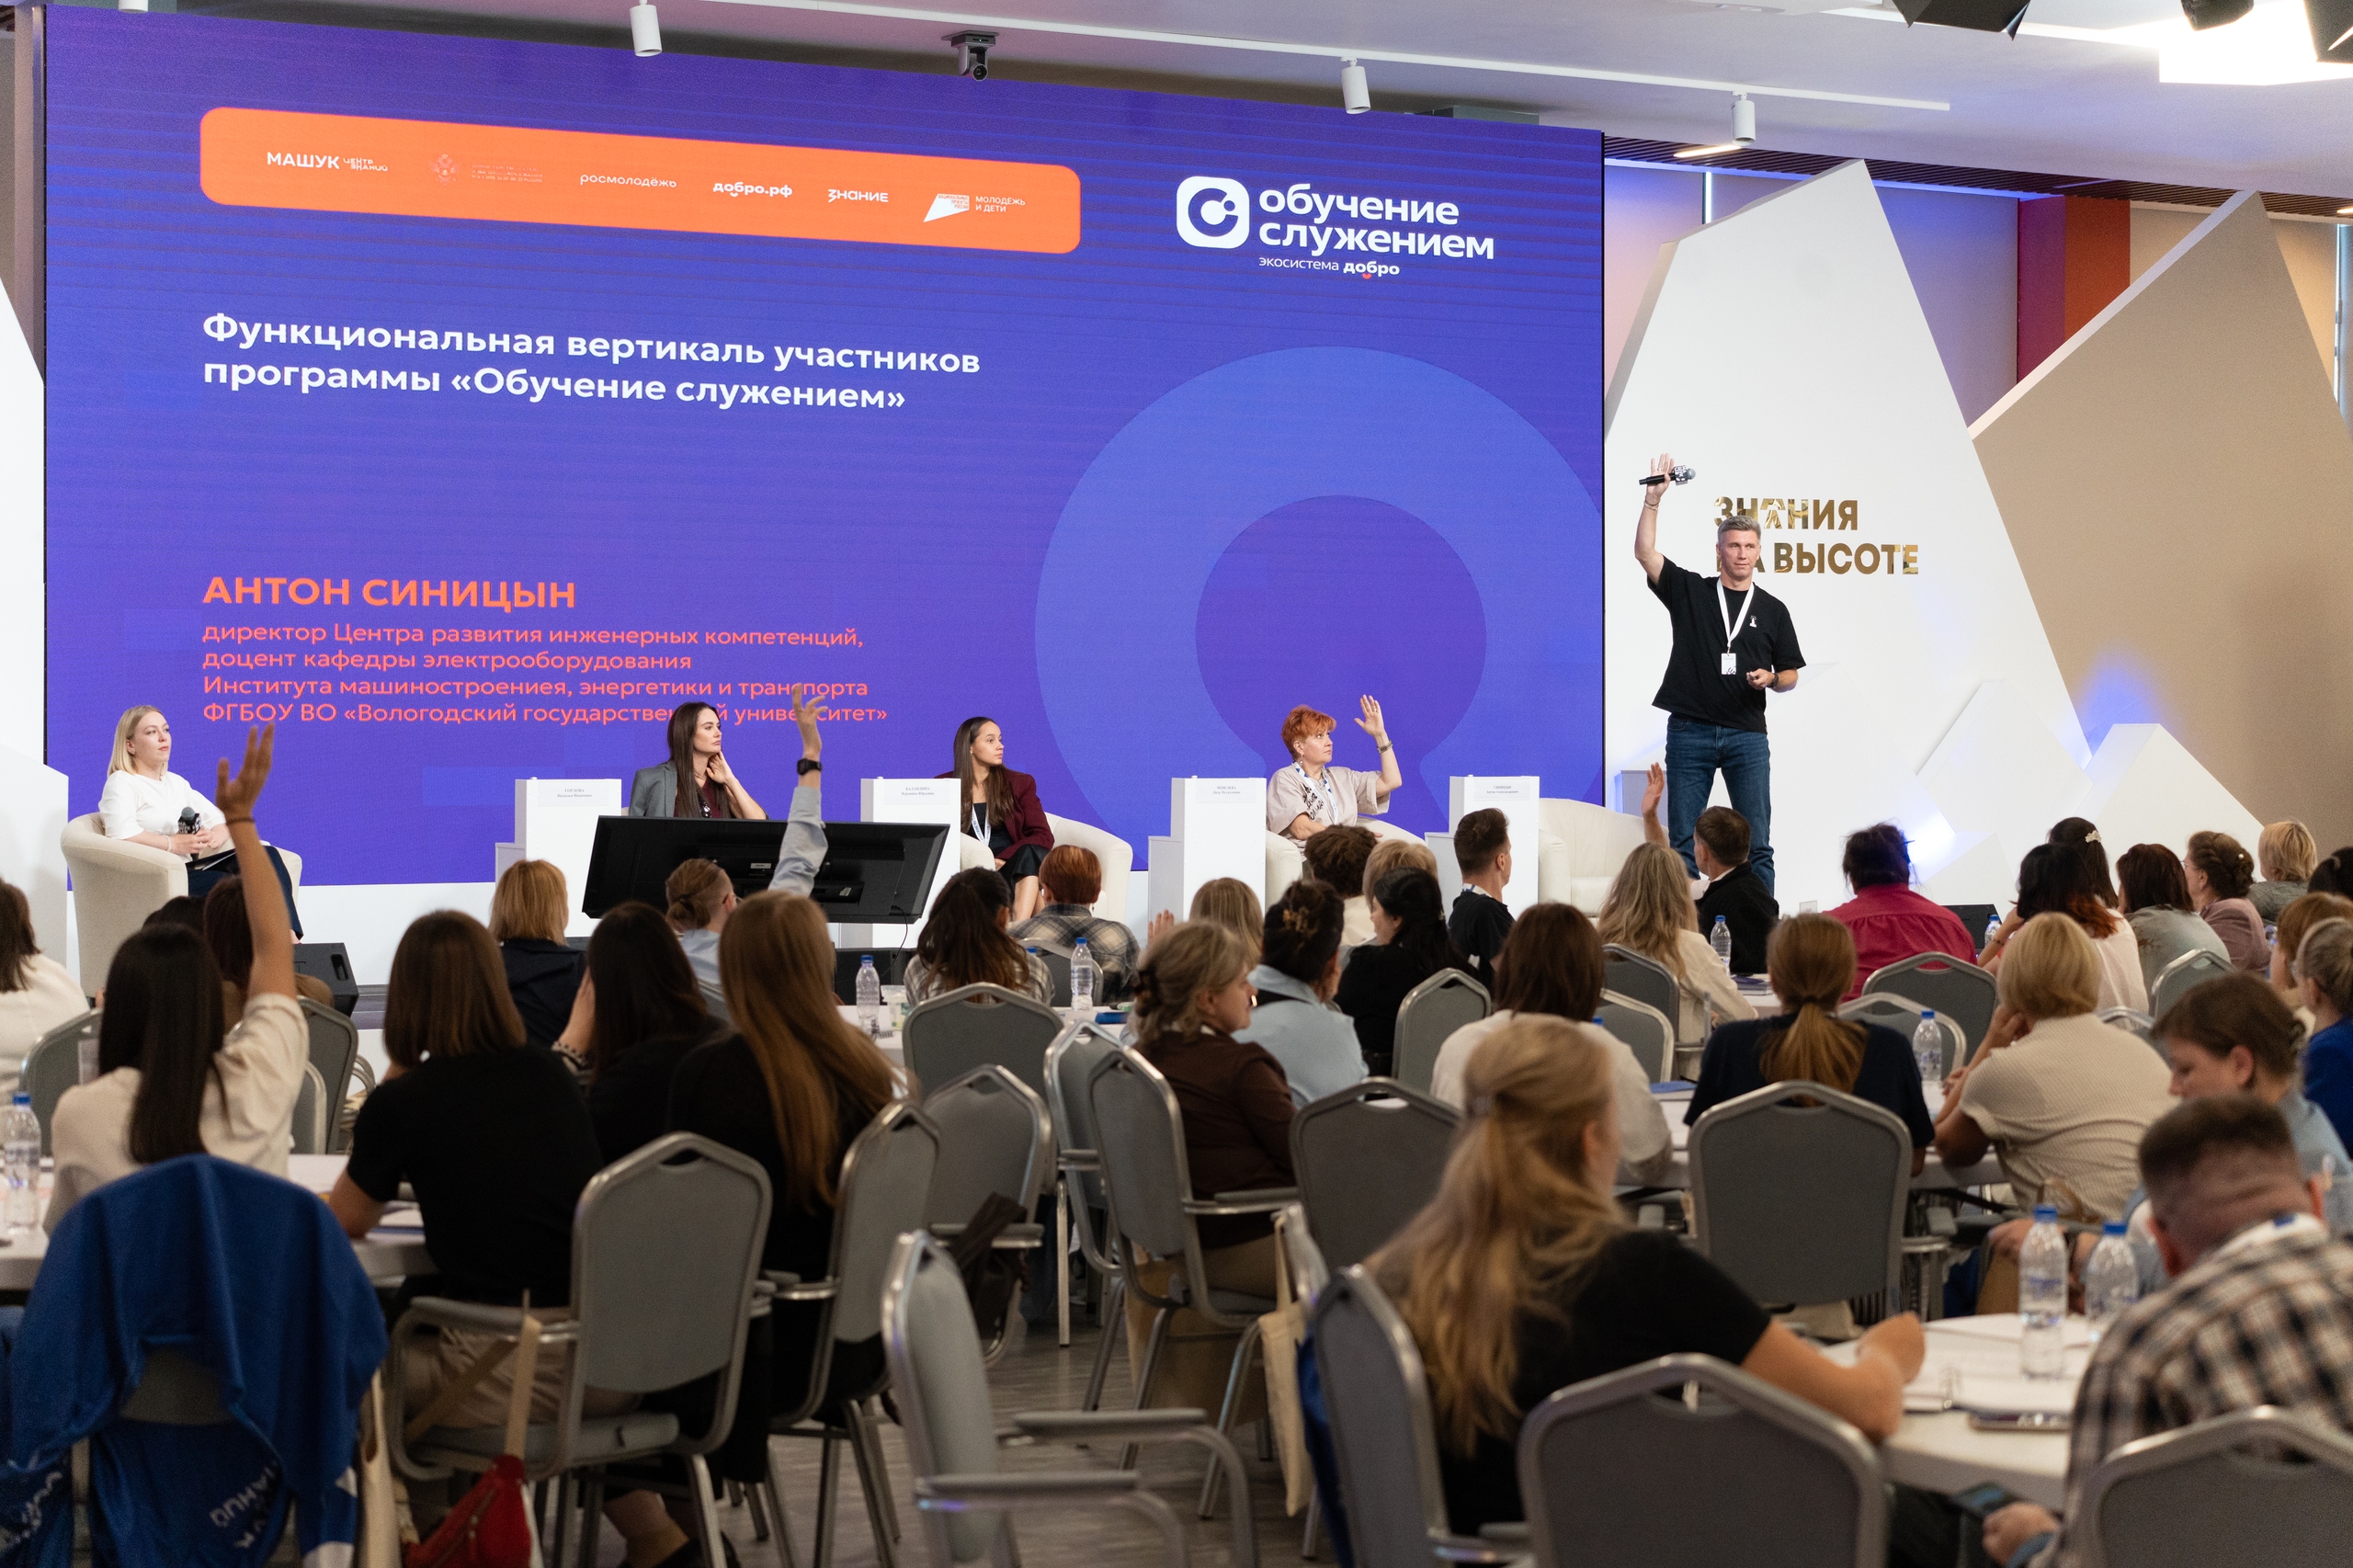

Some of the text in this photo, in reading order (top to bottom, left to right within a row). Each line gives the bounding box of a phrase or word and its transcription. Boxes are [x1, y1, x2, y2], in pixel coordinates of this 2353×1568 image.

[267, 152, 340, 169] МАШУК
[580, 175, 676, 187] росмолодёжь
[712, 182, 792, 198] добро.рф
[983, 204, 1006, 212] ДЕТИ
[1259, 184, 1459, 224] обучение
[1259, 222, 1495, 259] служением
[1259, 257, 1399, 277] экосистема добро
[204, 313, 980, 372] Функциональная вертикаль участников
[205, 364, 904, 409] программы «Обучение служением»
[1714, 496, 1859, 530] ЗНАНИЯ
[1774, 542, 1918, 574] ВЫСОТЕ
[203, 577, 574, 612] АНТОН СИНИЦЫН
[202, 624, 864, 647] директор Центра развития инженерных компетенций,
[203, 650, 690, 673] доцент кафедры электрооборудования
[205, 676, 868, 699] Института машиностроениея, энергетики и транпорта
[204, 703, 888, 725] ФГБОУ ВО «Вологодский государствей унивеситет»
